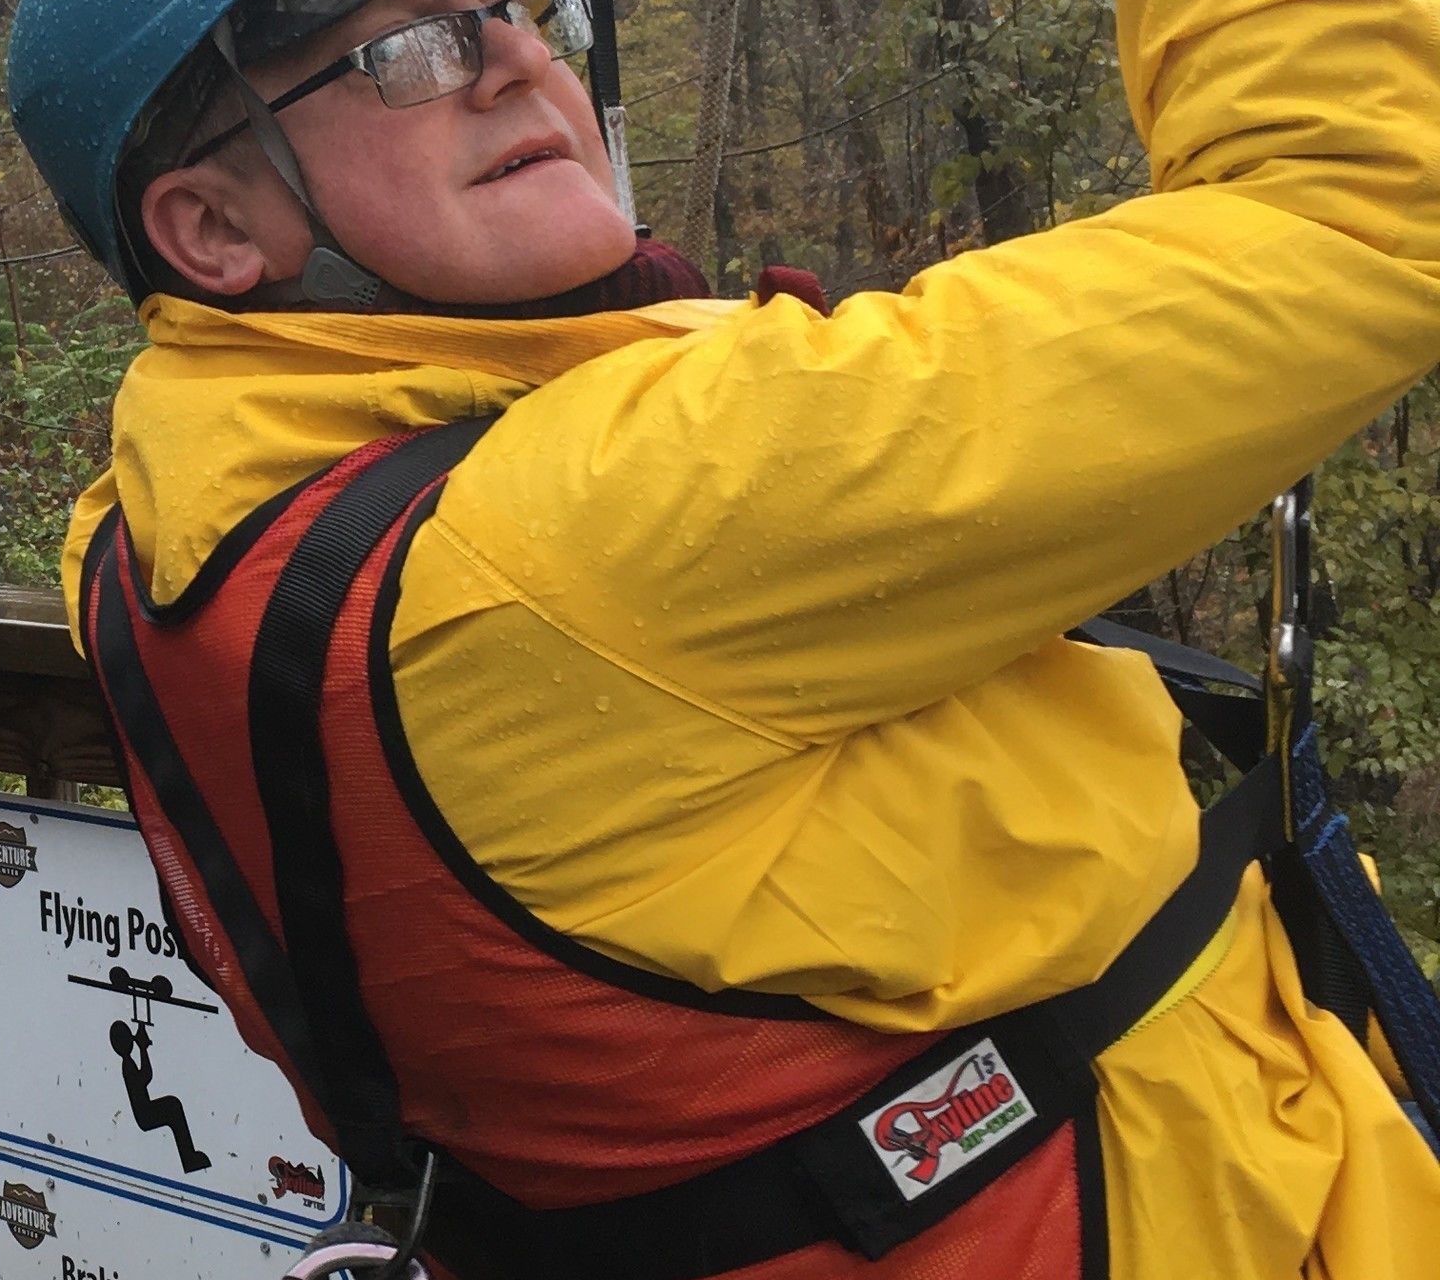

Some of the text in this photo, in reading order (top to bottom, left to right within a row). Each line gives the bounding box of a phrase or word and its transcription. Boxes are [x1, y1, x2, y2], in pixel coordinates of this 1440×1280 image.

[40, 890, 182, 960] Flying Pos
[0, 1200, 51, 1233] ADVENTURE
